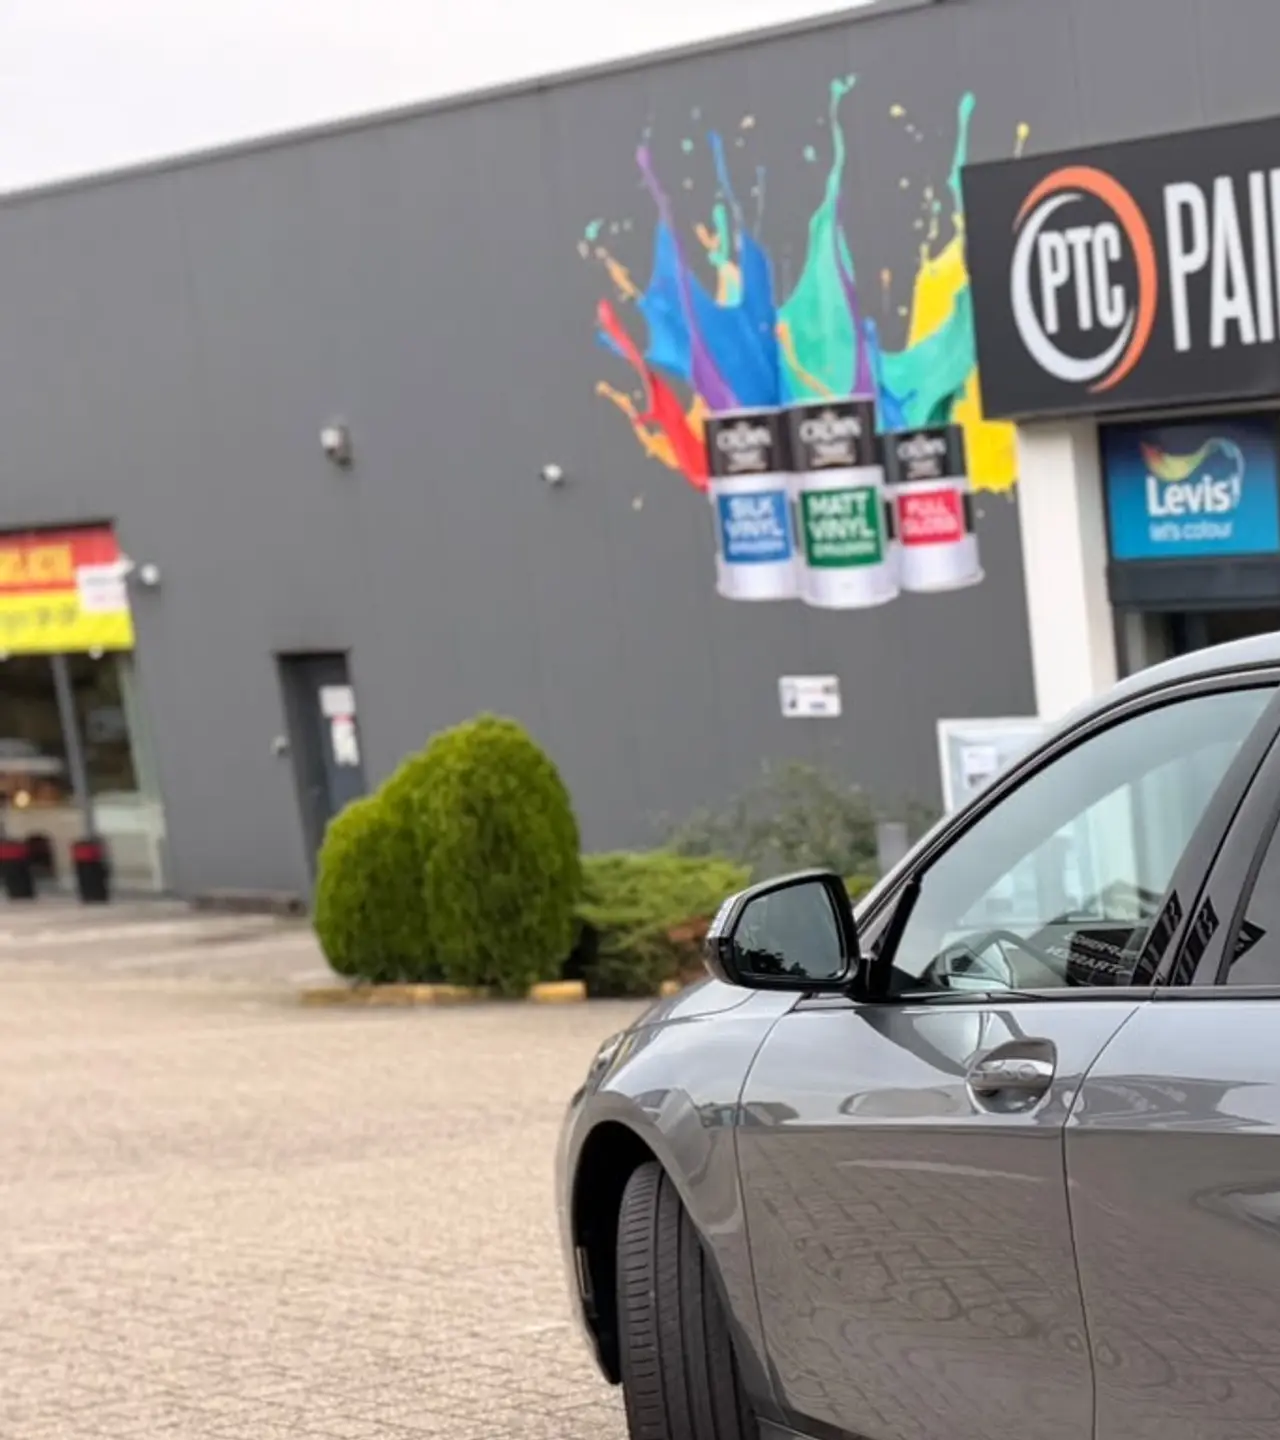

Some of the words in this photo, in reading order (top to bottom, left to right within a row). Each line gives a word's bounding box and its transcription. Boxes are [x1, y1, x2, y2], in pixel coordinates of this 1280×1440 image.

[1038, 222, 1124, 334] PTC
[729, 496, 774, 520] SILK
[807, 491, 870, 518] MATT
[725, 518, 785, 540] VINYL
[808, 516, 876, 540] VINYL
